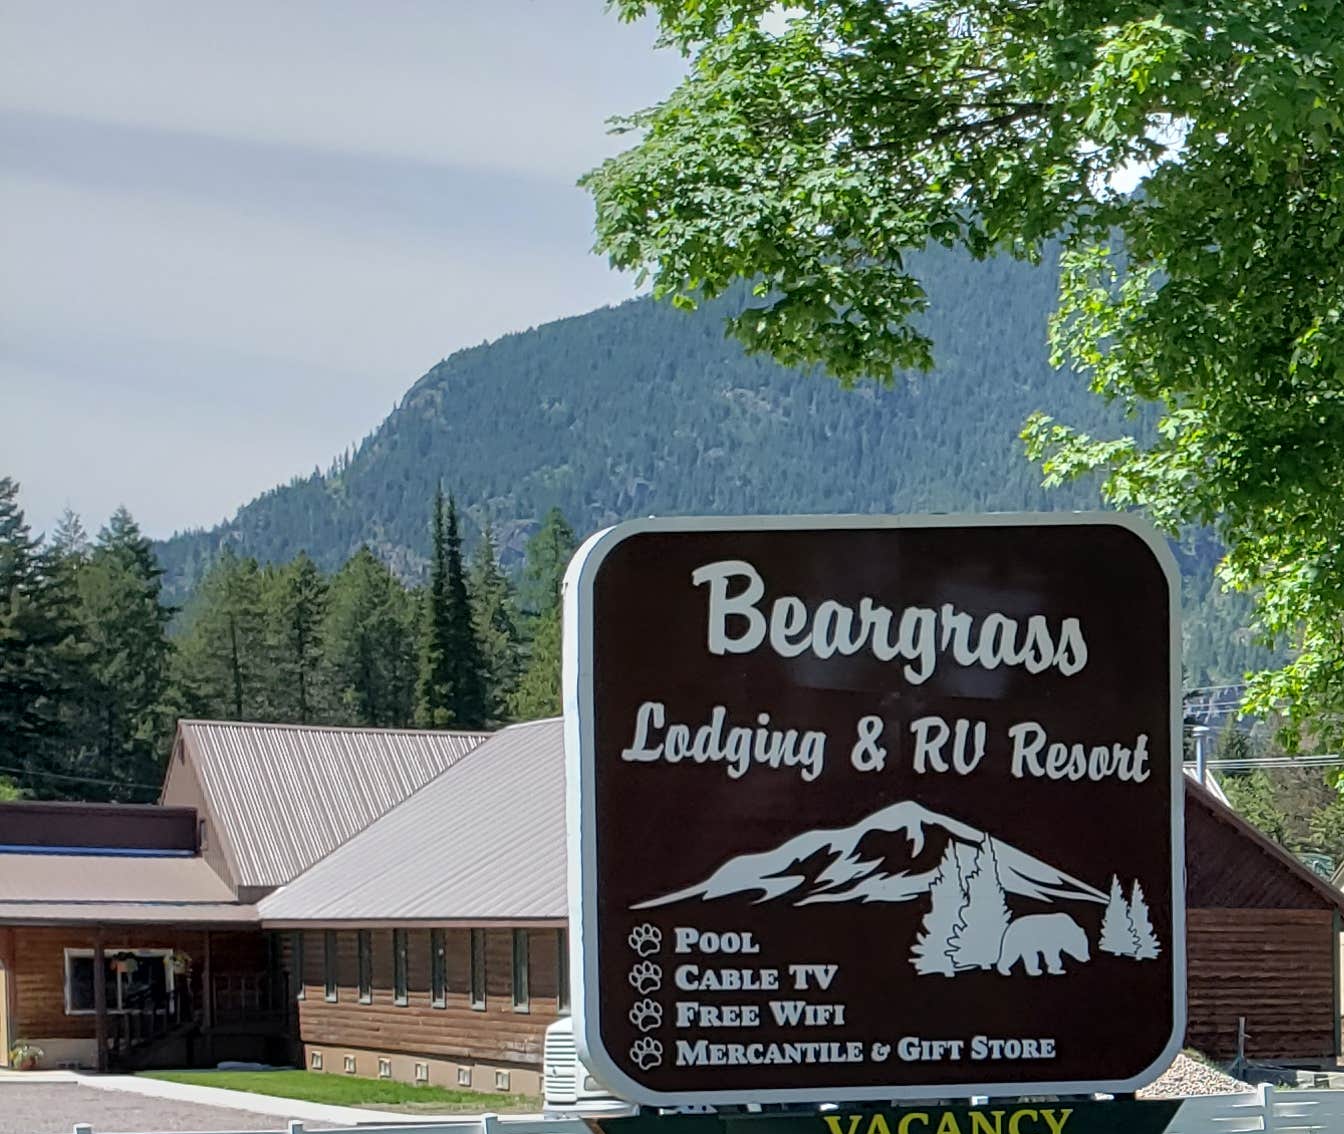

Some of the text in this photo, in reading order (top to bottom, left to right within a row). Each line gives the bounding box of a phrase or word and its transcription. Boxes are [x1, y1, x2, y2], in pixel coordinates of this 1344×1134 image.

[692, 560, 1088, 685] Beargrass
[621, 702, 1151, 783] Lodging & RV Resort
[788, 964, 839, 990] TV
[870, 1042, 891, 1062] &
